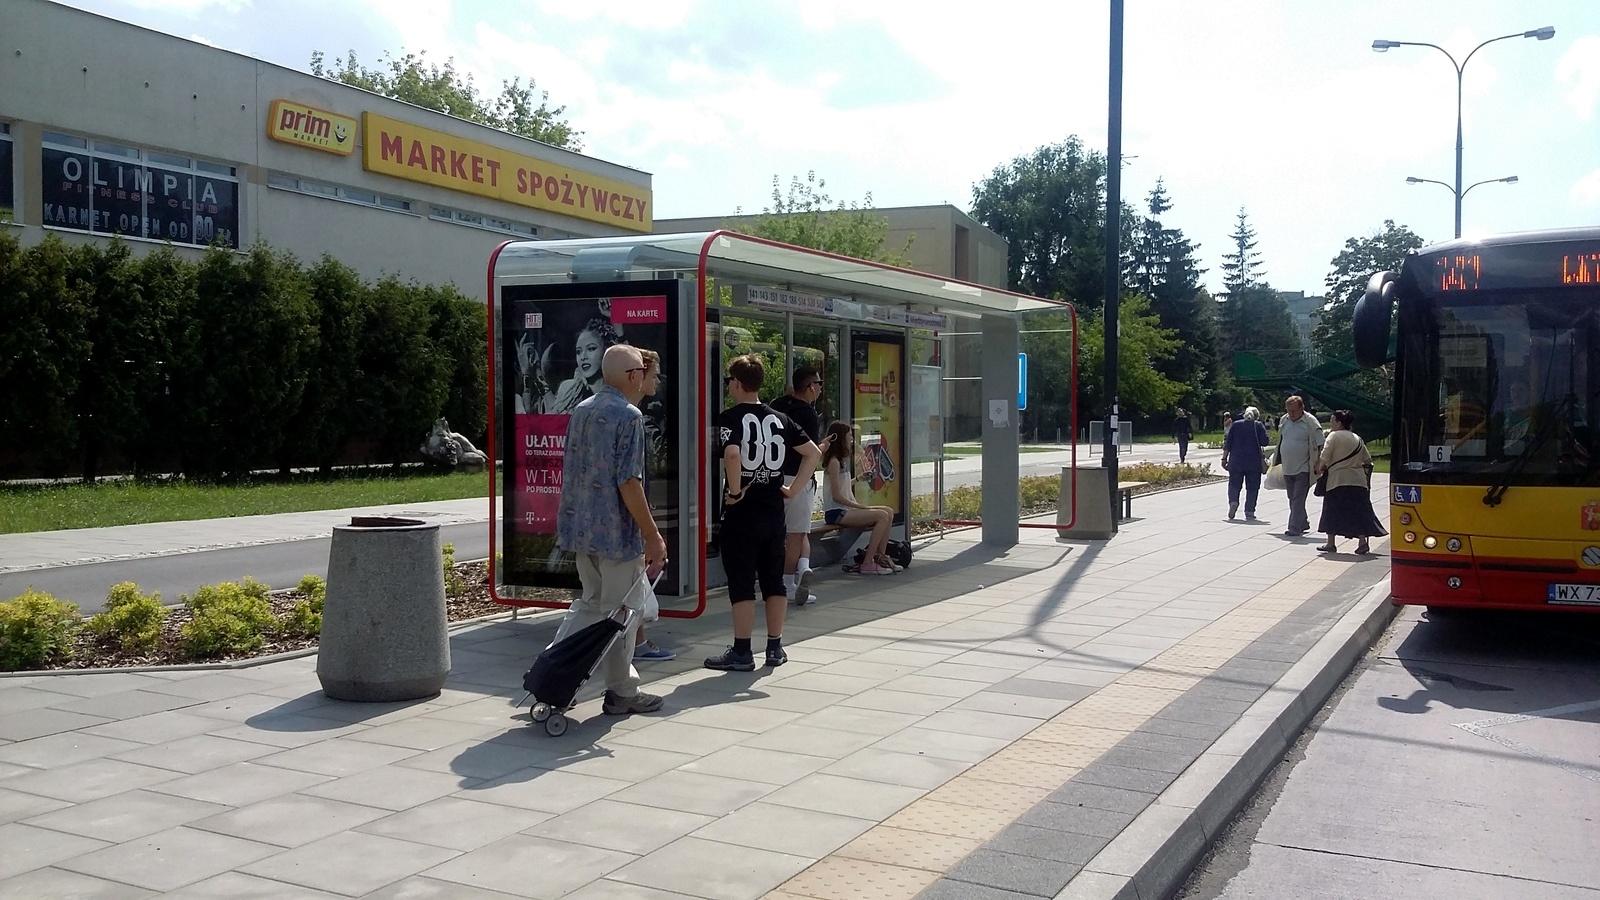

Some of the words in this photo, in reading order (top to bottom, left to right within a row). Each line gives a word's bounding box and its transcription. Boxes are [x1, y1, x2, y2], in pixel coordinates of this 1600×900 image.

[280, 109, 331, 138] prim
[63, 157, 217, 204] OLIMPIA
[380, 131, 500, 187] MARKET
[517, 168, 647, 222] SPOŻYWCZY
[44, 203, 111, 228] KARNET
[120, 213, 161, 237] OPEN
[169, 221, 189, 237] OD
[626, 310, 636, 318] NA
[637, 309, 659, 318] KARTĘ
[741, 413, 785, 471] 06
[1436, 447, 1443, 461] 6
[525, 469, 538, 484] W
[1558, 585, 1580, 600] WX
